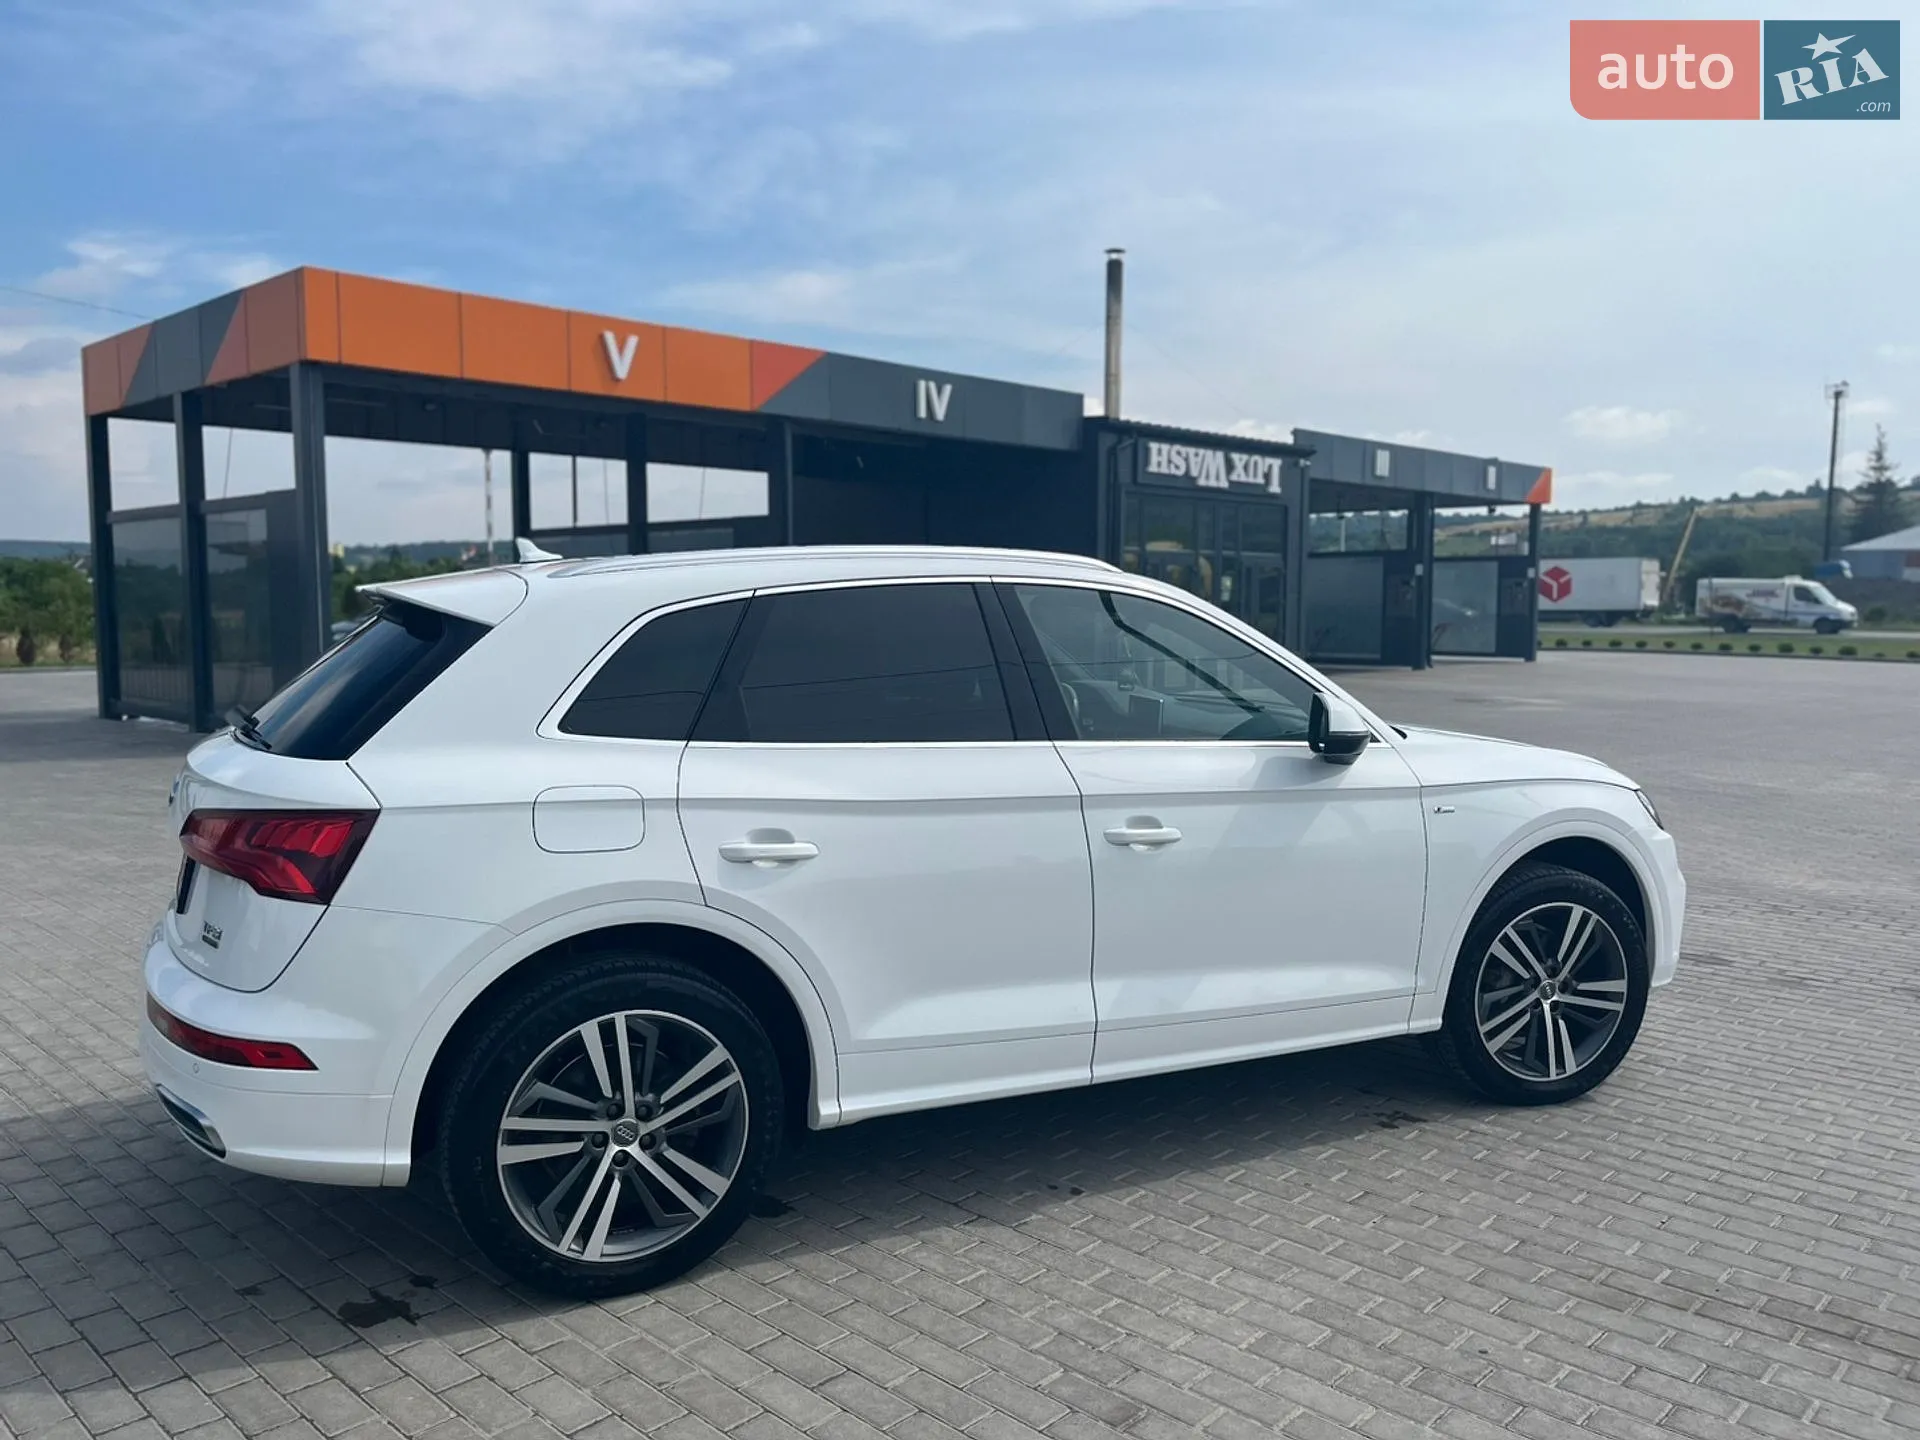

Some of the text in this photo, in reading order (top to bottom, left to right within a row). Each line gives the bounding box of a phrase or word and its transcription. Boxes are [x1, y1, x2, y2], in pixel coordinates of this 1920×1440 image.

[603, 330, 639, 381] V
[916, 379, 953, 422] IV
[1147, 442, 1282, 494] LUX WASH
